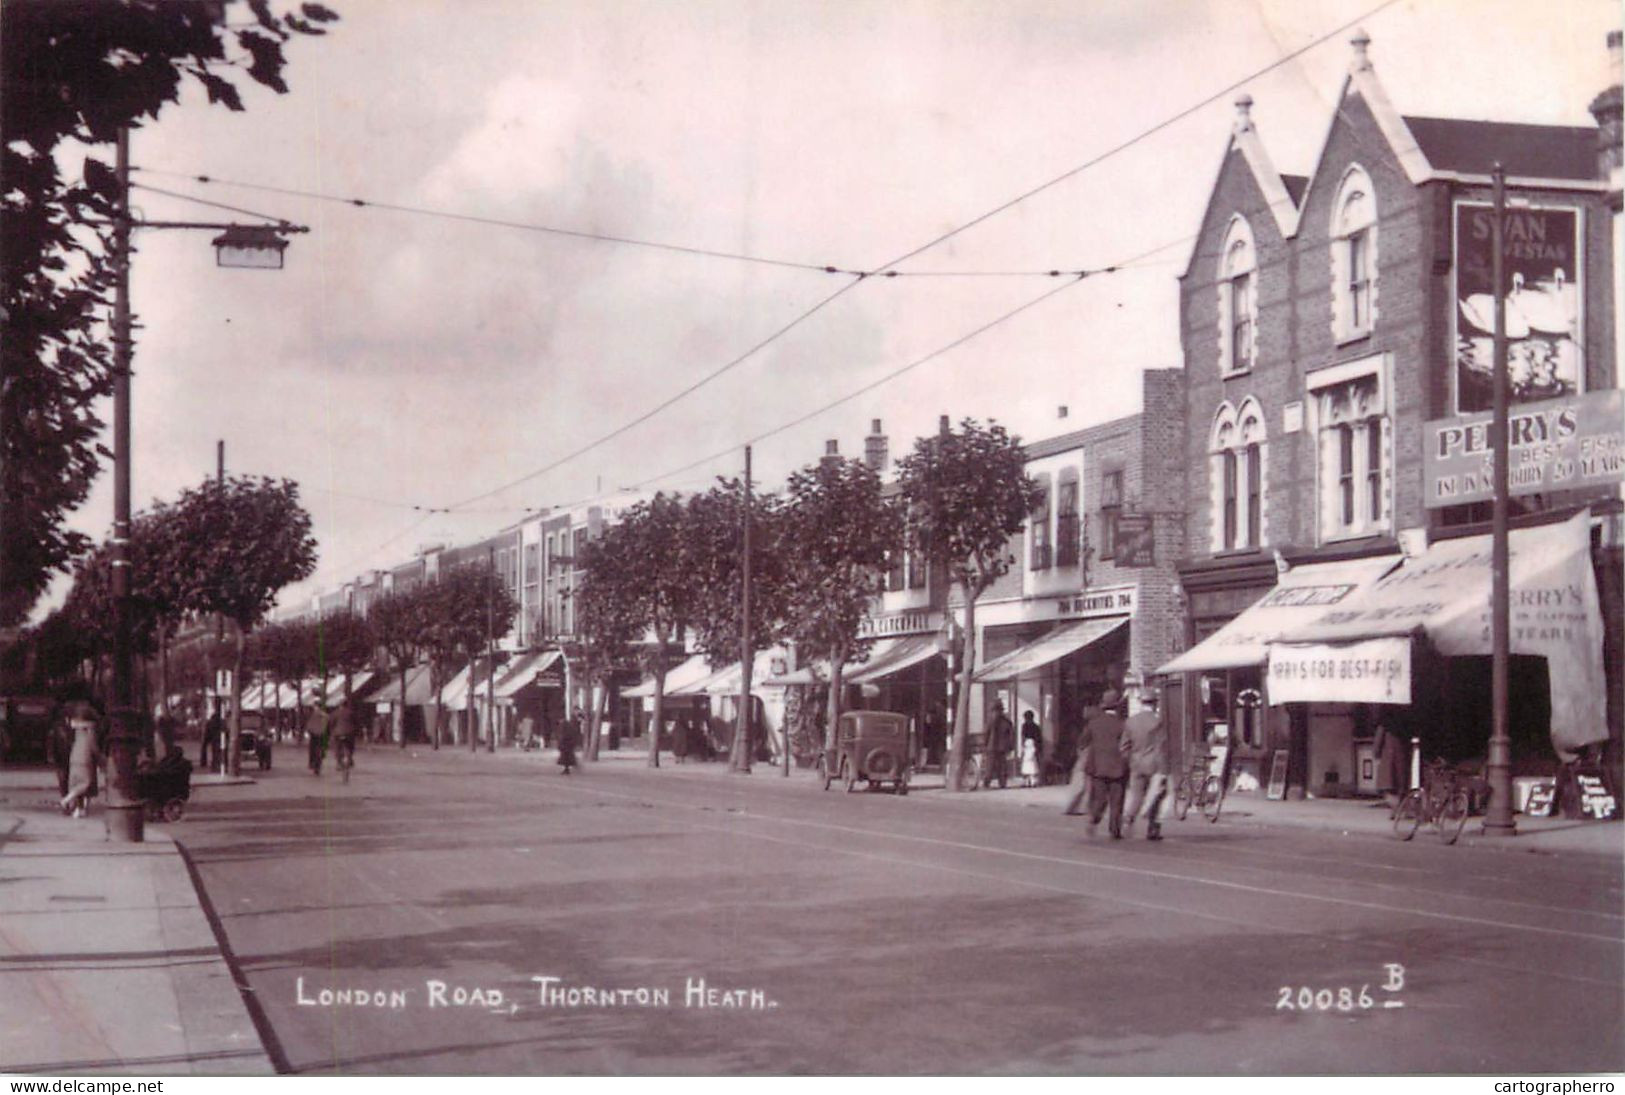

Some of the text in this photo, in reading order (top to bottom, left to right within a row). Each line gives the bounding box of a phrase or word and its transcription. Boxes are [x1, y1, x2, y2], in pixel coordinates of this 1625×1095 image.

[1521, 436, 1619, 462] BEST FISH
[1311, 660, 1335, 679] FOR
